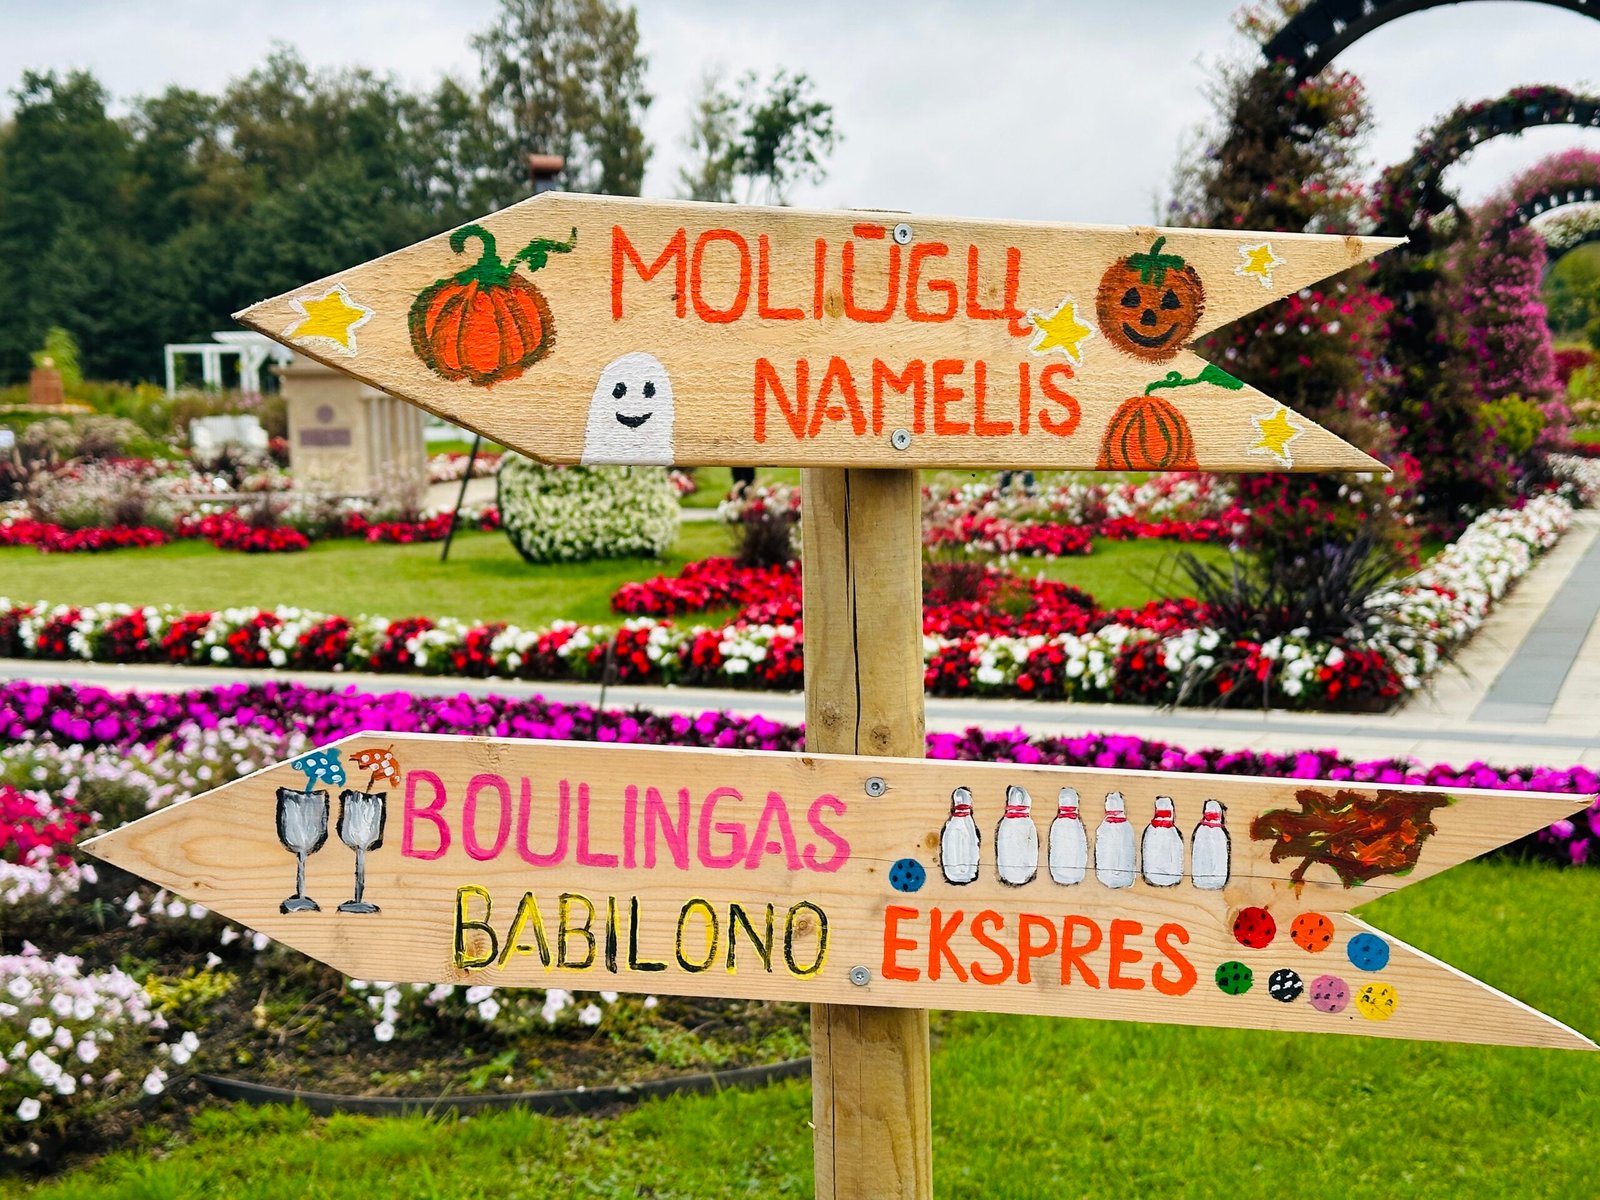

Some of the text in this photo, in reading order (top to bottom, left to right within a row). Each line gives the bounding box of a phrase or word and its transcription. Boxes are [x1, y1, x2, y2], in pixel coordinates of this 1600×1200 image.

[612, 223, 1033, 337] MOLIŪGŲ
[754, 356, 1082, 443] NAMELIS
[401, 769, 851, 873] BOULINGAS
[453, 884, 1197, 996] BABILONO EKSPRES
